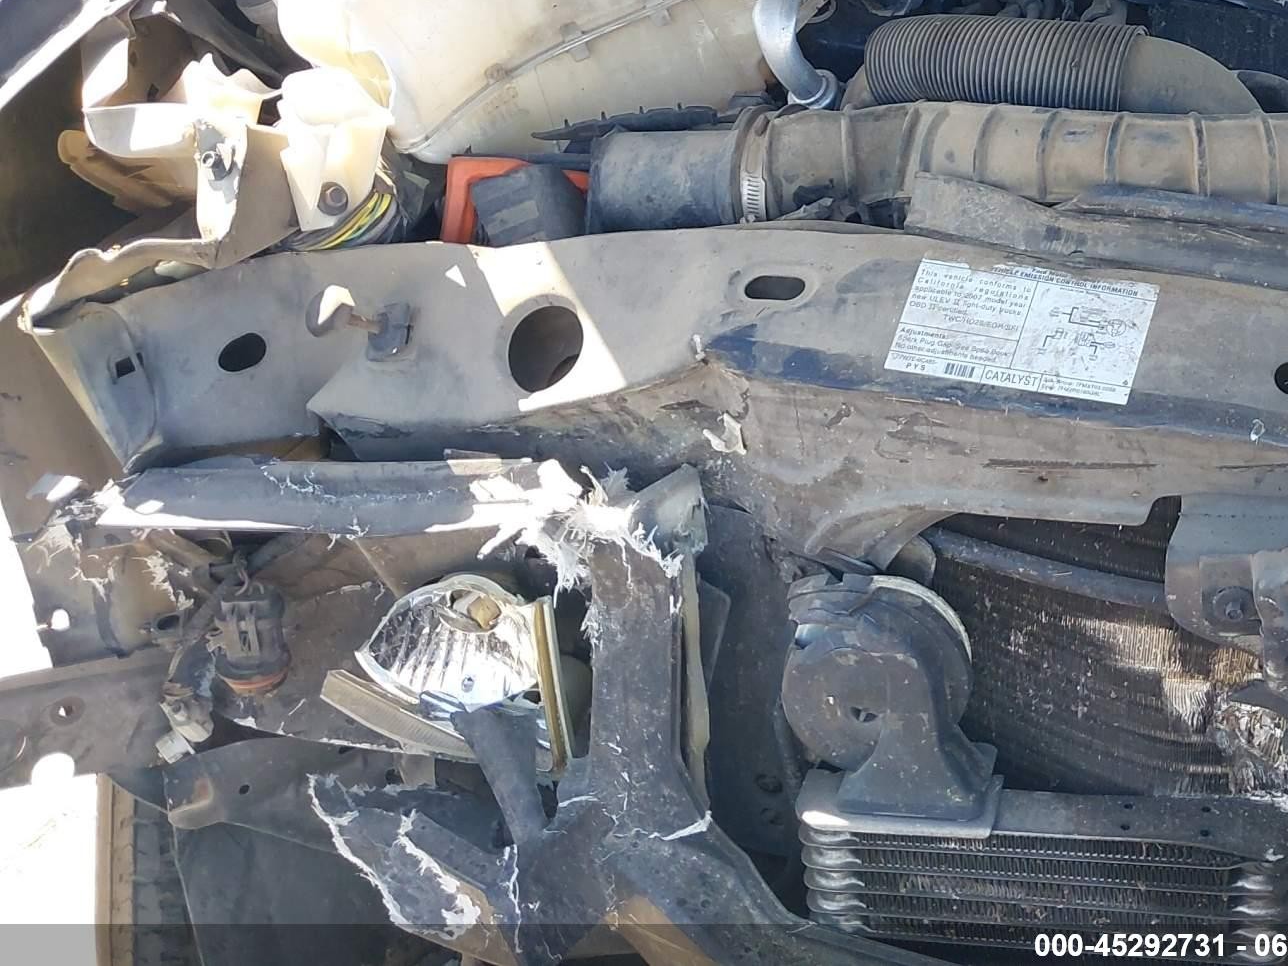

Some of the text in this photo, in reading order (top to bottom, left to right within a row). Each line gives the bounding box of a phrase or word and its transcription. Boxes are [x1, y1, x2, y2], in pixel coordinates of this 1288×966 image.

[917, 277, 1029, 300] California regulations
[921, 268, 938, 278] This
[944, 273, 973, 282] vehicle
[979, 280, 1017, 290] conforms
[1020, 270, 1054, 282] EMISSION
[1056, 277, 1087, 288] CONTROL
[1090, 282, 1139, 297] INFORMATION
[914, 285, 952, 296] applicable
[929, 295, 950, 304] ULEV
[984, 369, 1038, 388] CATALYST
